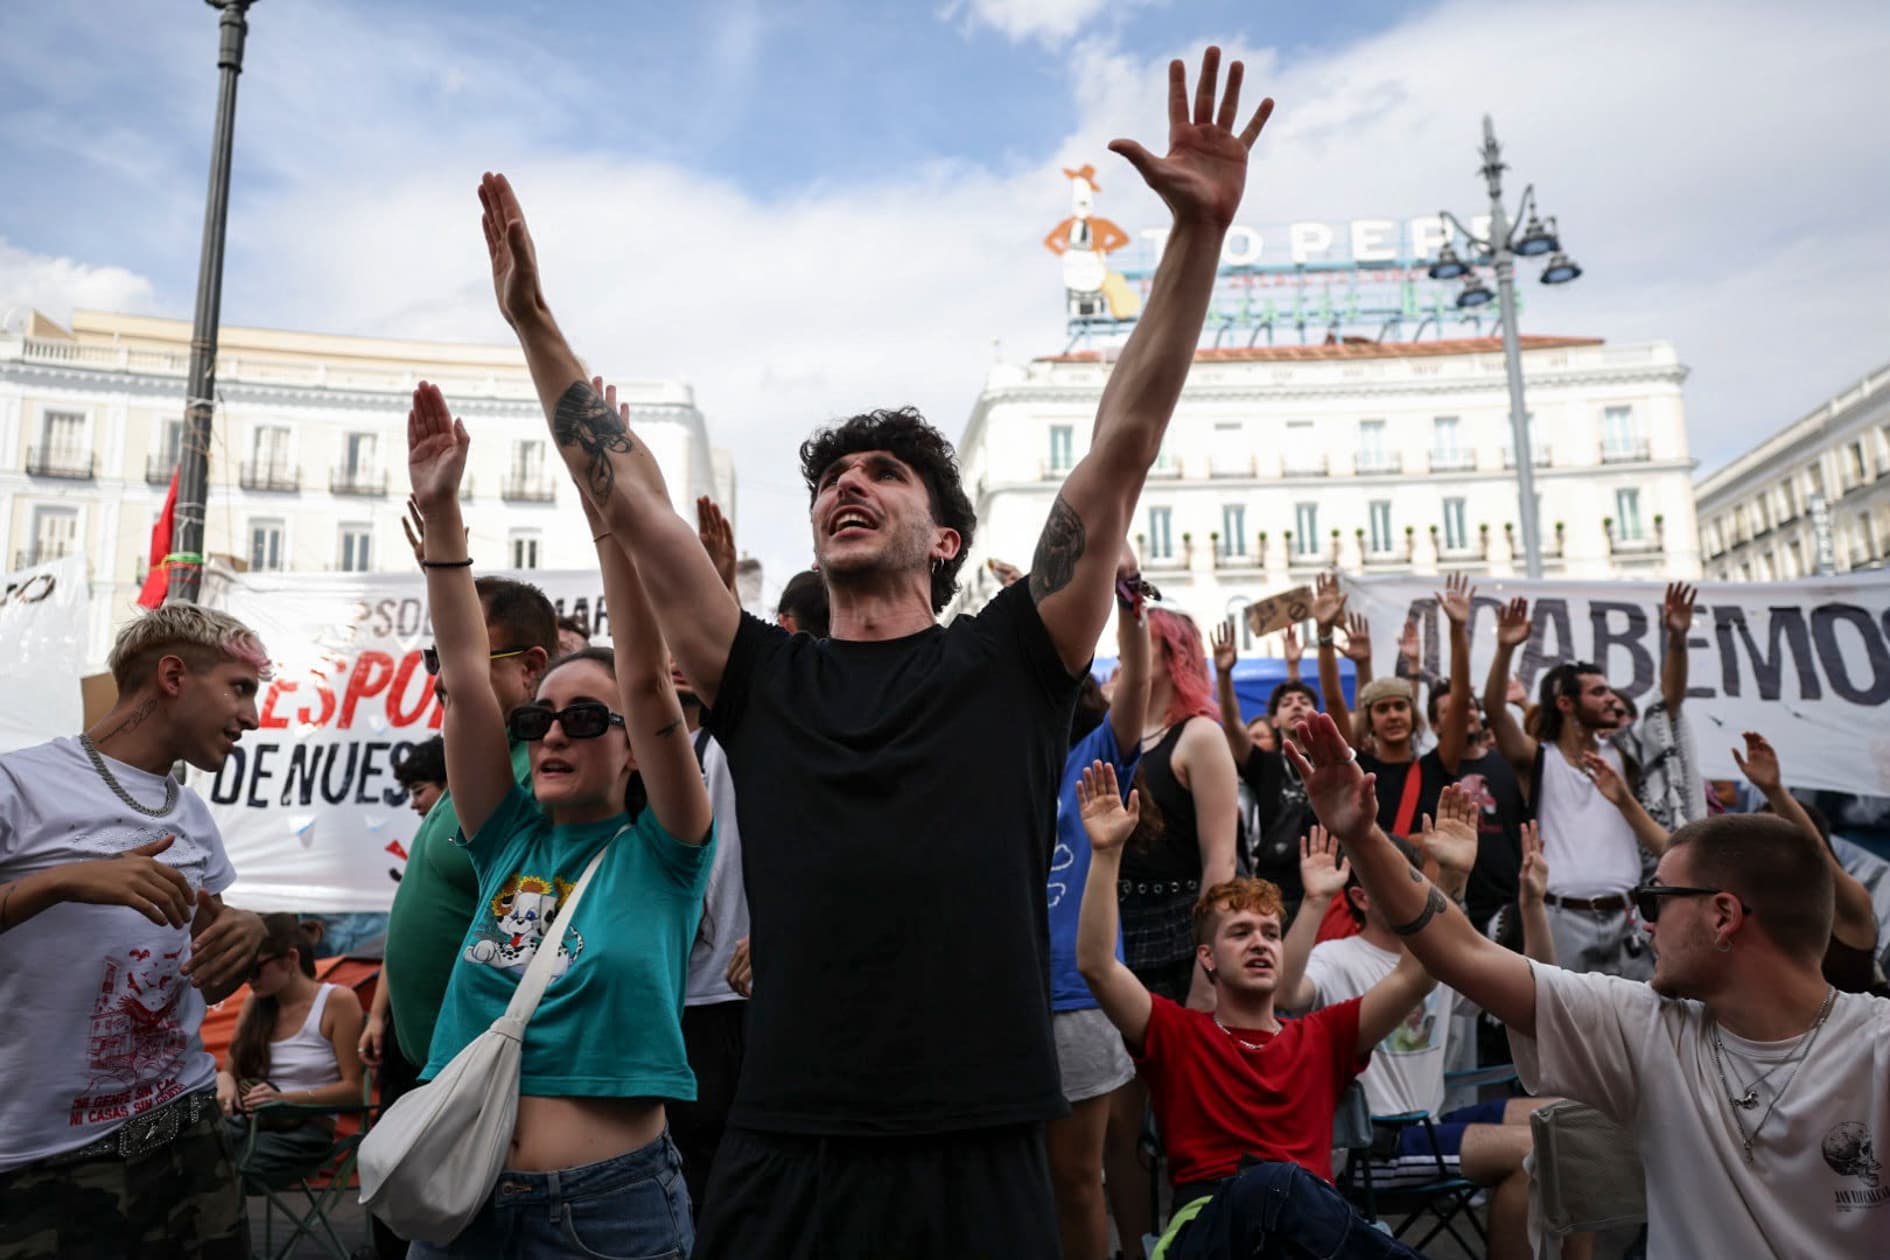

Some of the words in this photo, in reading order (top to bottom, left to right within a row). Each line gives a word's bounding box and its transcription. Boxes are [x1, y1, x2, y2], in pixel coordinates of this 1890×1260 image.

[1138, 224, 1264, 267] TO
[1396, 594, 1890, 706] AABEMO
[210, 743, 280, 808] DE
[280, 741, 412, 807] NUES
[69, 1111, 84, 1127] NI
[88, 1106, 129, 1122] CASAS
[134, 1099, 153, 1115] SIN
